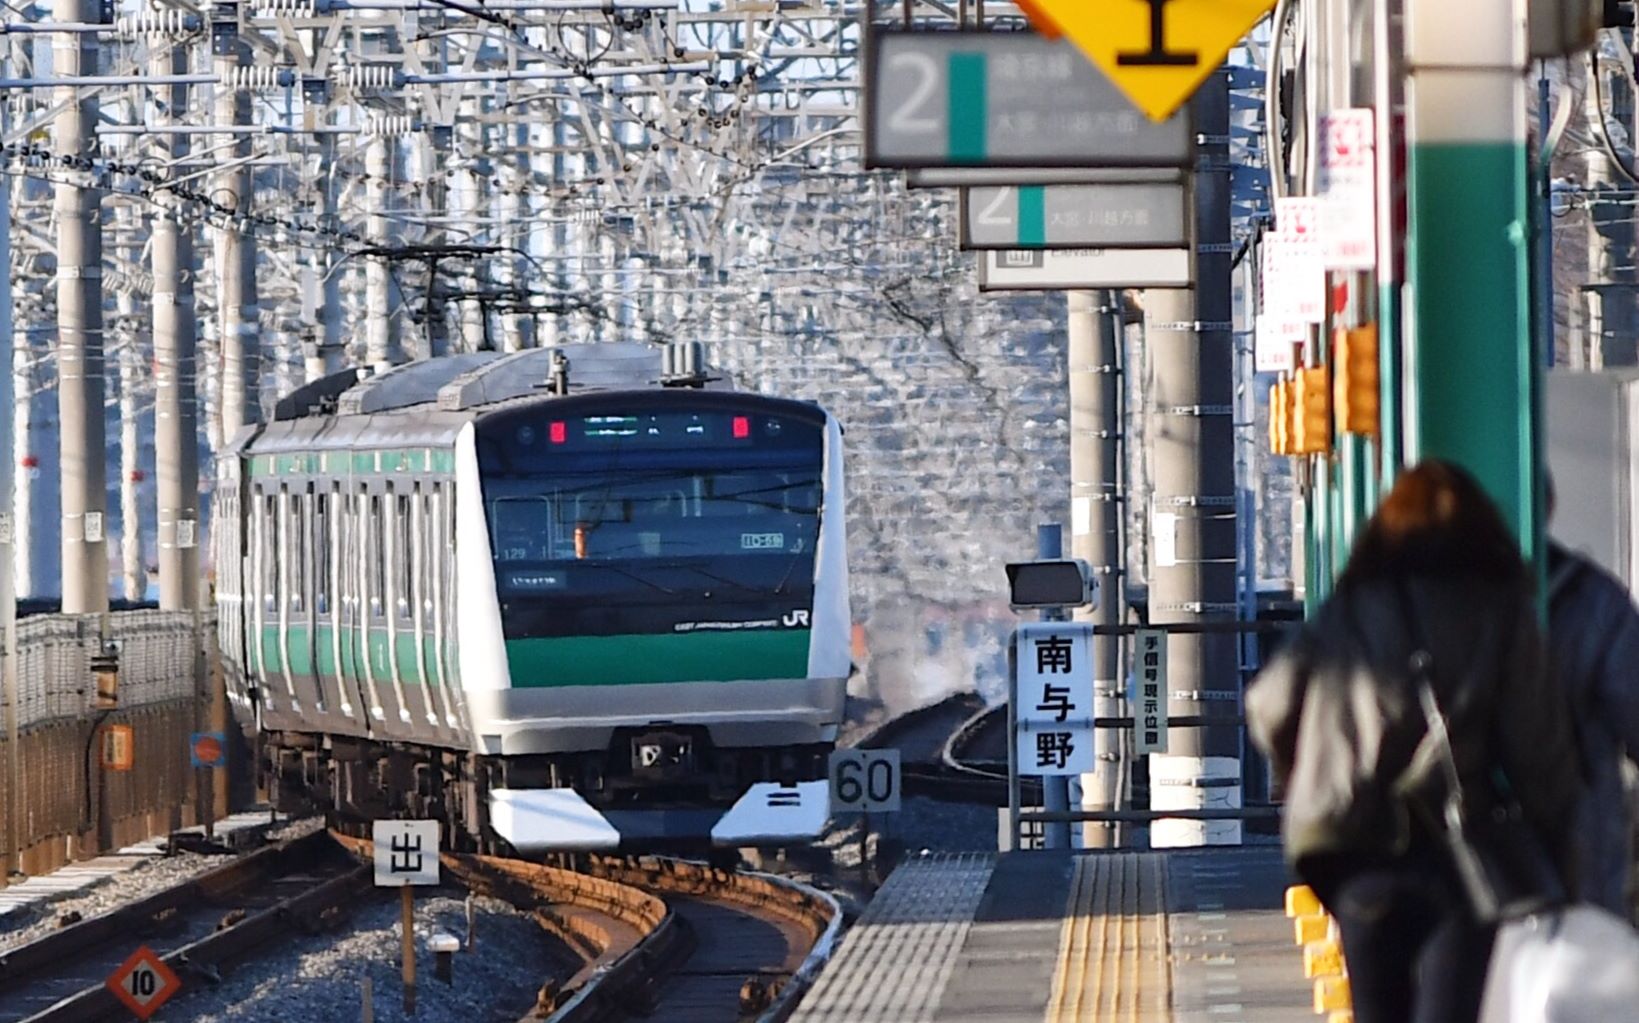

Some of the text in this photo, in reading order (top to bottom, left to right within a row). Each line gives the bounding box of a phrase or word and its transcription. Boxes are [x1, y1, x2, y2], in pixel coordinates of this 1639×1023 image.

[889, 53, 939, 131] 2
[978, 186, 1012, 224] 2
[782, 609, 809, 626] JR
[1034, 635, 1076, 769] 南与野
[836, 759, 893, 803] 60
[390, 832, 422, 873] 出
[132, 970, 156, 996] 10
